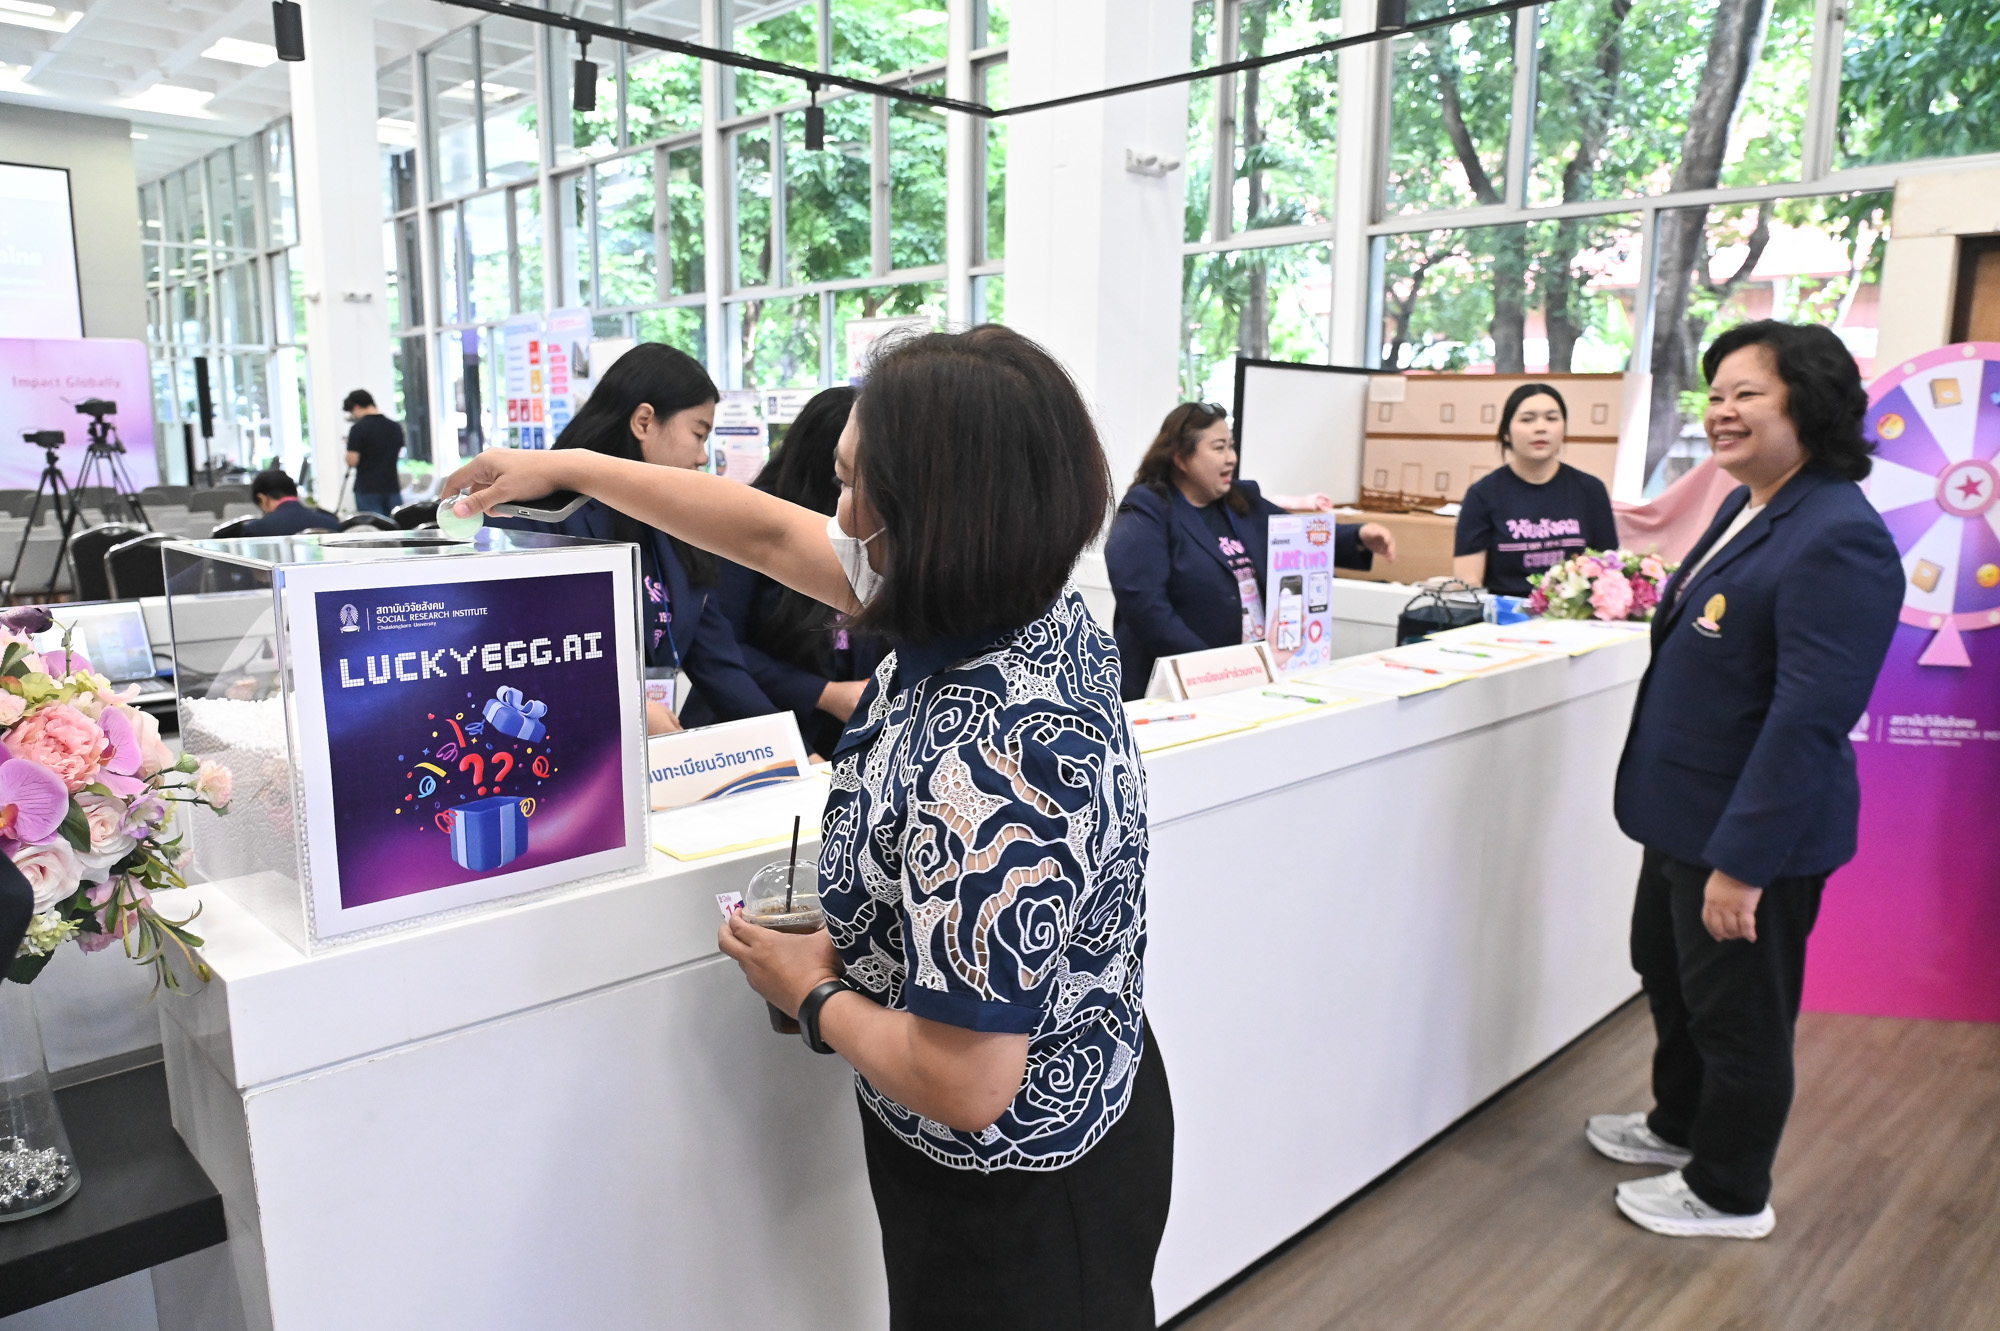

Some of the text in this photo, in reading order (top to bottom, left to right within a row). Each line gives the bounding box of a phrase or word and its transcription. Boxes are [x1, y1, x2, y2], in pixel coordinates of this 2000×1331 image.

[11, 375, 120, 390] Impact Globally
[1273, 549, 1302, 572] LIKE
[376, 601, 445, 615] สถาบันวิจัยสังคม
[376, 607, 488, 624] SOCIAL RESEARCH INSTITUTE
[339, 631, 603, 688] LUCKYEGG.AI
